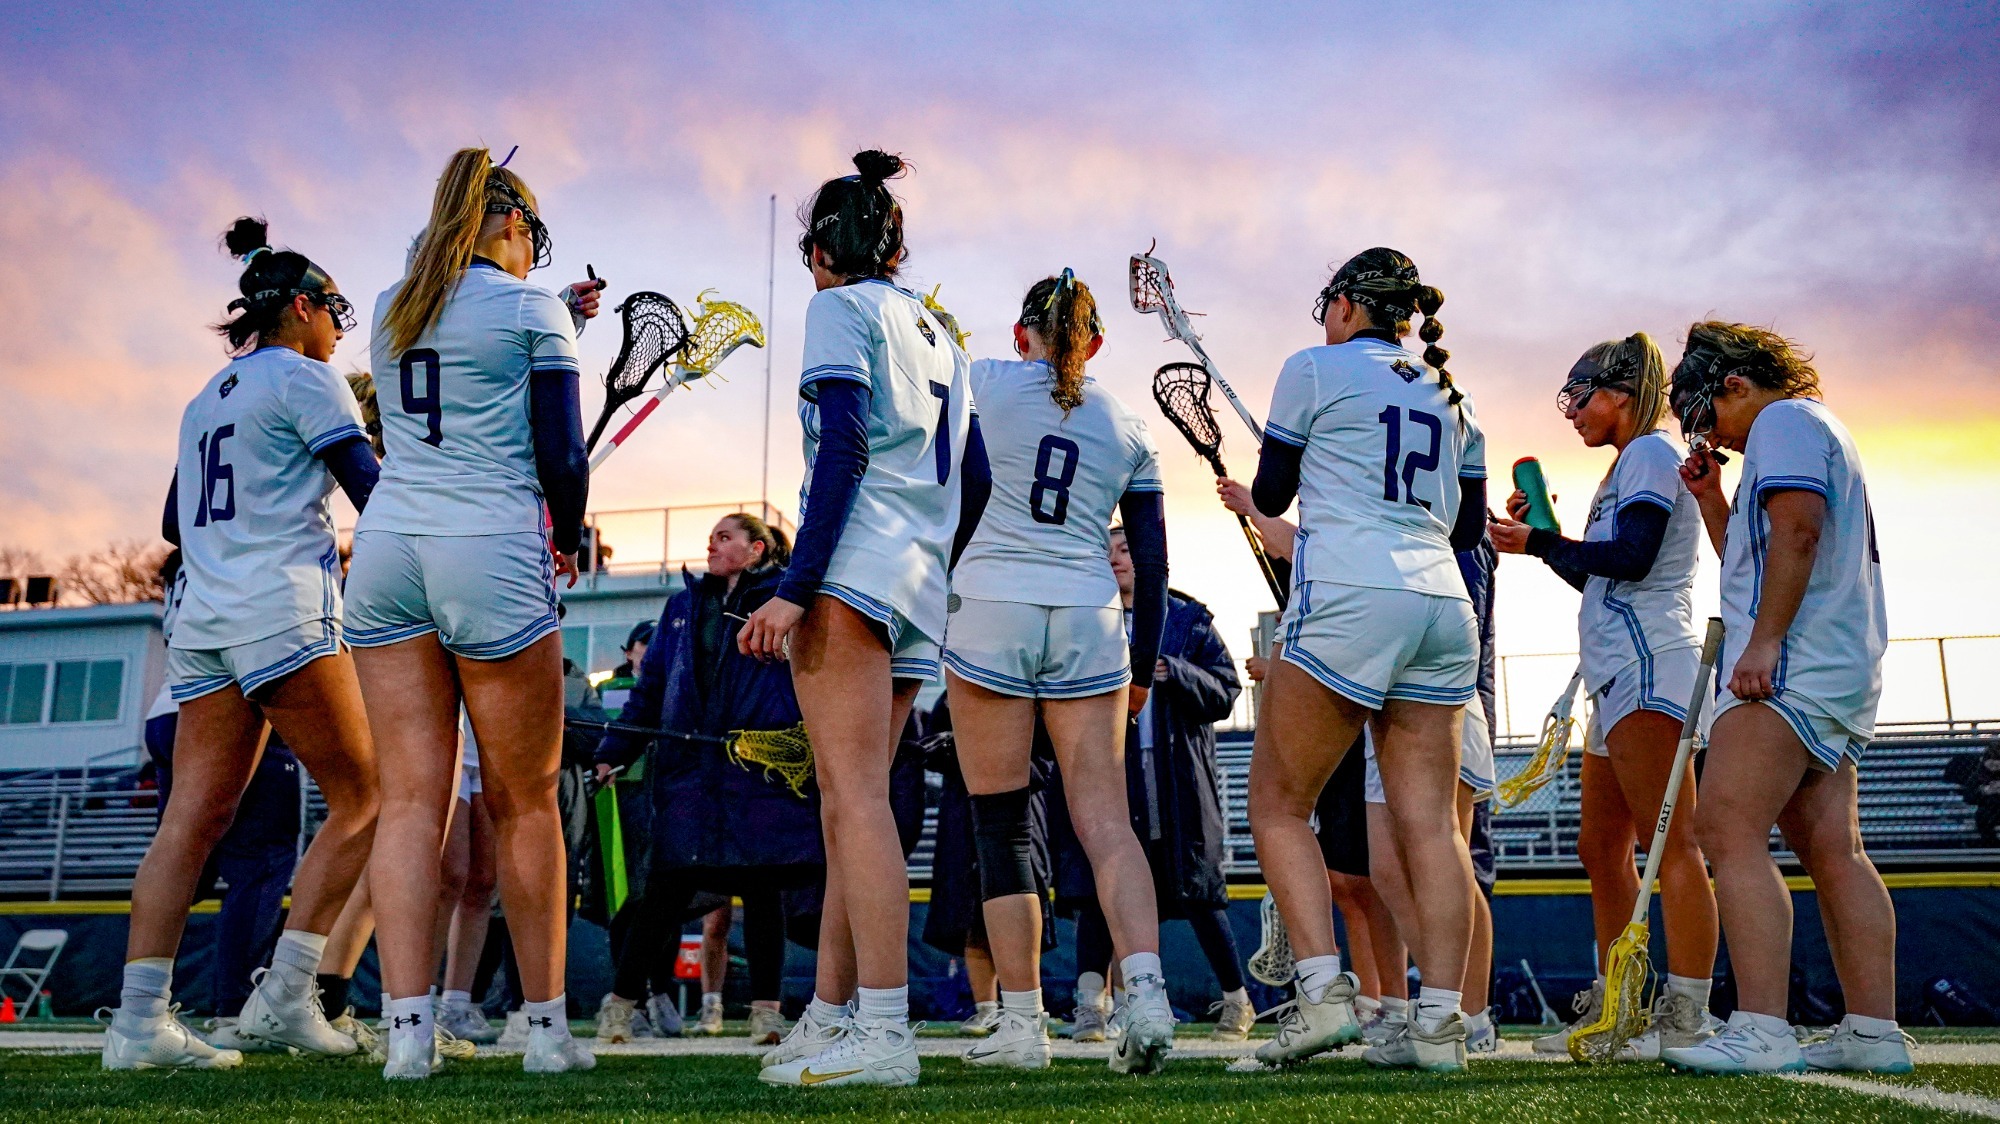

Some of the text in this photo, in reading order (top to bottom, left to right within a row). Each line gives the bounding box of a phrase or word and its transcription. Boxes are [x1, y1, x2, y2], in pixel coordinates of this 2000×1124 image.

[816, 211, 840, 231] STX
[1357, 269, 1383, 281] STX
[255, 288, 281, 300] STX
[1328, 278, 1349, 294] STX
[1352, 292, 1378, 307] STX
[1023, 314, 1040, 325] STX
[1384, 303, 1407, 317] STX
[1600, 363, 1622, 379] STX
[399, 348, 443, 450] 9
[1219, 379, 1237, 399] GAIT
[929, 379, 951, 487] 7
[1378, 404, 1442, 512] 12
[193, 423, 235, 527] 16
[1029, 434, 1079, 525] 8
[1657, 801, 1671, 833] GAIT
